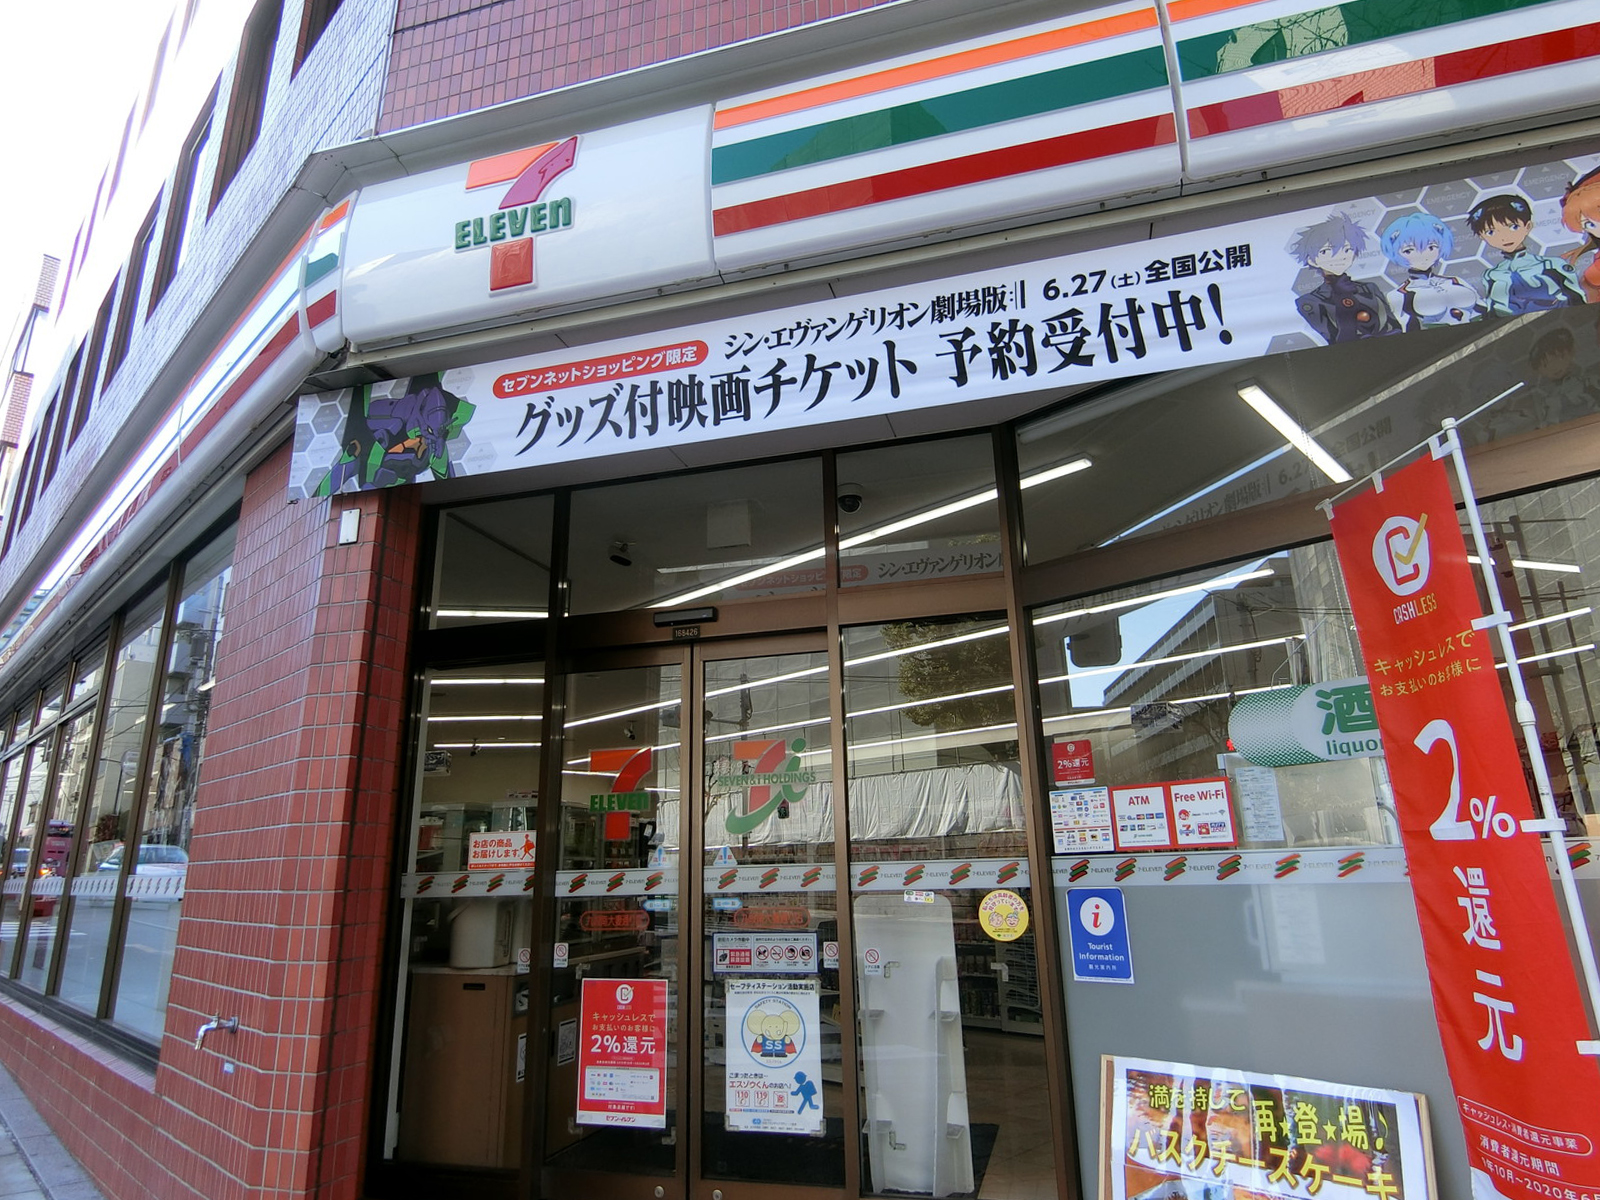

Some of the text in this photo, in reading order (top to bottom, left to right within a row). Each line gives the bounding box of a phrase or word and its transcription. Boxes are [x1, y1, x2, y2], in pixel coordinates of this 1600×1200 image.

[502, 345, 698, 393] セブンネットショッピング限定
[515, 283, 1233, 456] グッズ付映画チケット 予約受付中!
[1393, 593, 1438, 625] CASHLESS
[1374, 630, 1476, 676] キャッシュレスで
[1315, 684, 1379, 735] 酒
[763, 771, 816, 785] HOLDINGS
[1128, 795, 1150, 806] ATM
[1173, 788, 1225, 803] Free Wi-Fi
[472, 838, 512, 849] お店の商品
[1087, 942, 1113, 951] Tourist
[1078, 952, 1125, 962] Information
[592, 1011, 656, 1023] キャッシュレスで
[590, 1034, 656, 1054] 2%還元
[765, 1040, 783, 1050] SS
[1149, 1084, 1247, 1111] 満を持して
[1128, 1127, 1398, 1200] バスクチーズケーキ
